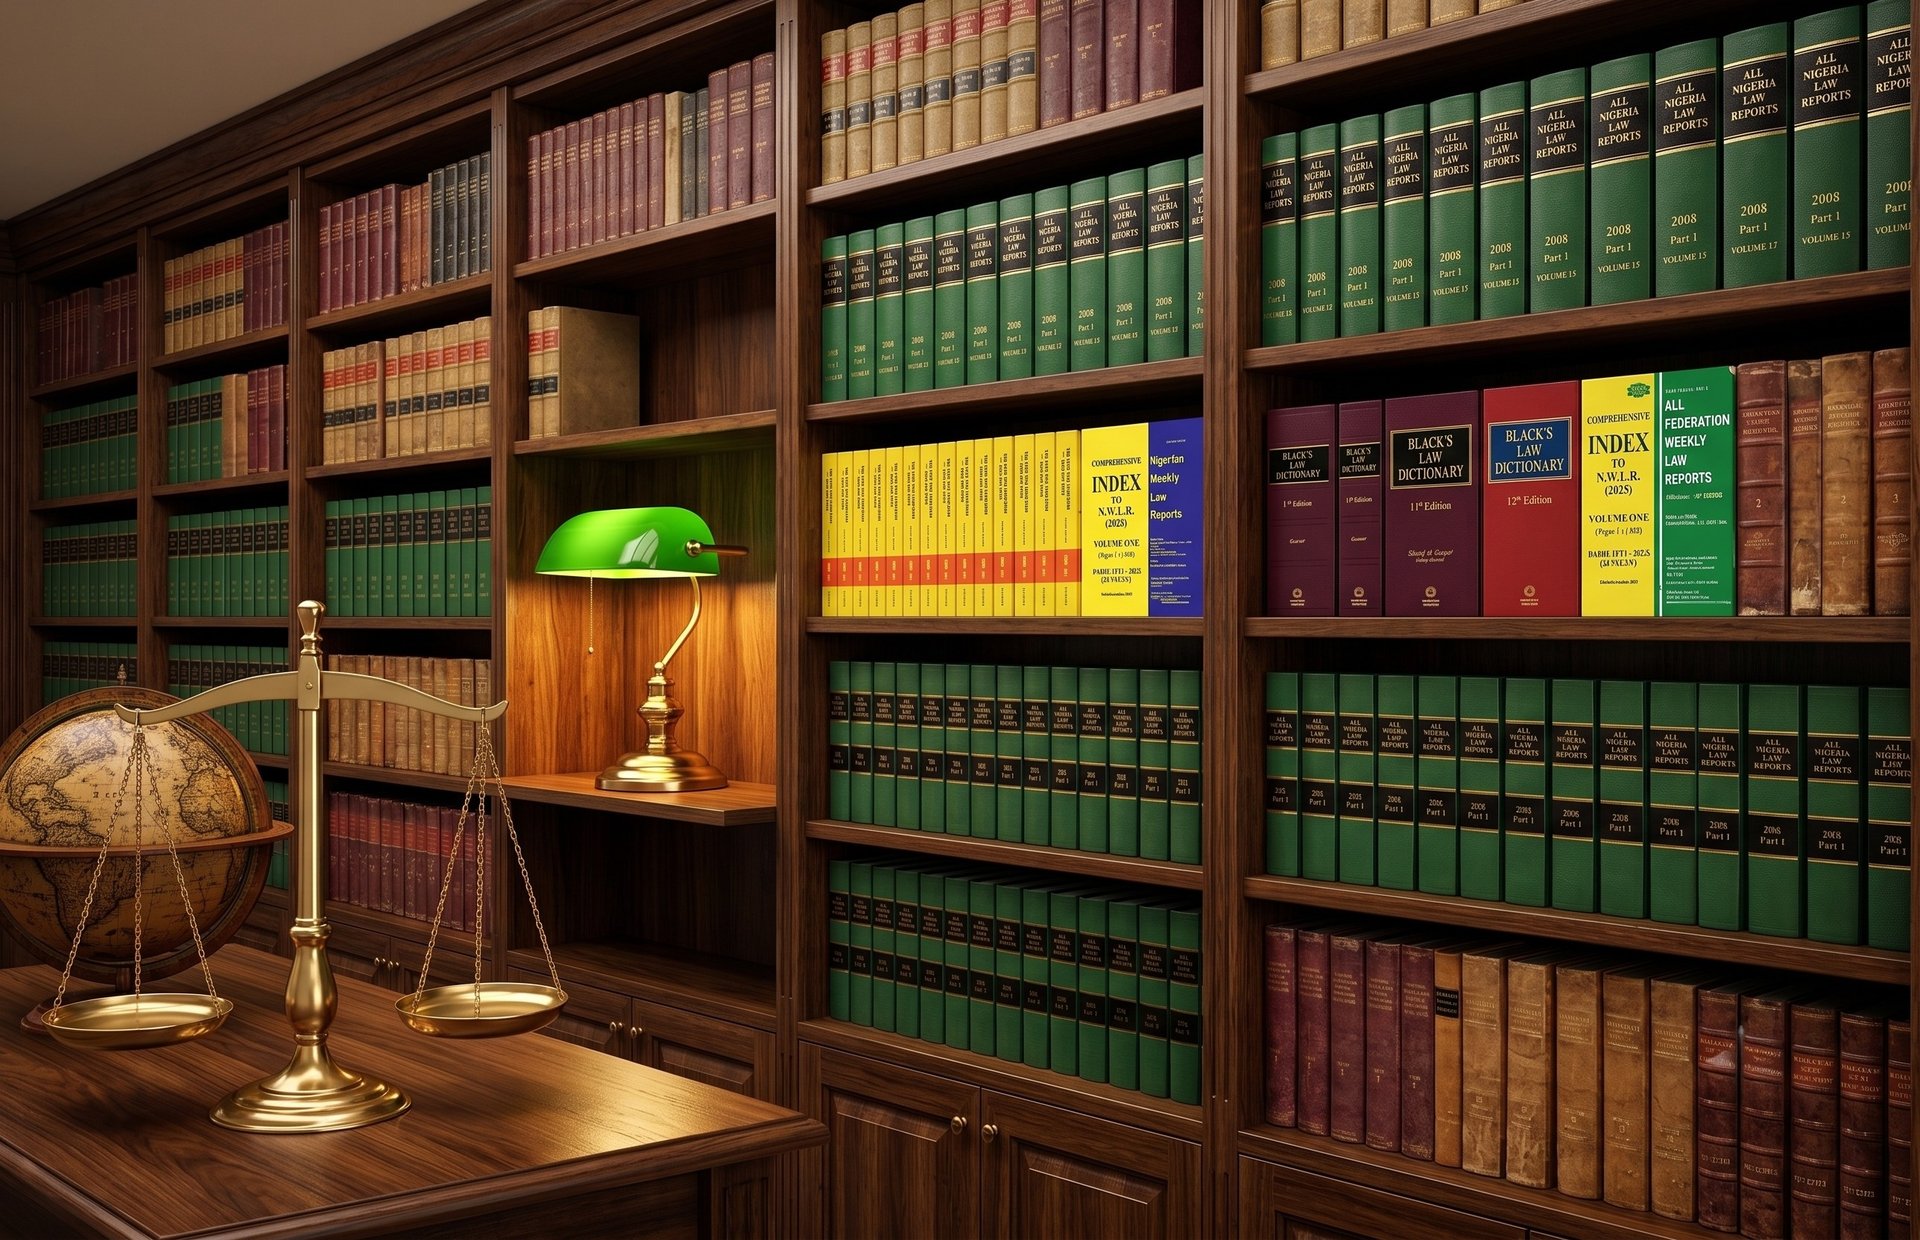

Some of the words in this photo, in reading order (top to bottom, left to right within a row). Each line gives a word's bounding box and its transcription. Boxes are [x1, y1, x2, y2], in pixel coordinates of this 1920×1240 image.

[1890, 37, 1910, 49] ALL
[1816, 53, 1836, 65] ALL
[1744, 68, 1763, 80] ALL
[1803, 64, 1849, 81] NIGERIA
[1675, 83, 1694, 94] ALL
[1733, 79, 1776, 95] NIGERIA
[1814, 79, 1838, 91] LAW
[1611, 97, 1628, 108] ALL
[1664, 93, 1706, 109] NIGERIA
[1743, 93, 1765, 105] LAW
[1802, 90, 1851, 107] REPORTS
[1548, 110, 1565, 121] ALL
[1599, 107, 1639, 122] NIGERIA
[1674, 107, 1696, 119] LAW
[1731, 104, 1778, 121] REPORTS
[1494, 122, 1509, 132] ALL
[1537, 120, 1575, 134] NIGERIA
[1609, 120, 1630, 132] LAW
[1663, 118, 1708, 134] REPORTS
[1443, 133, 1458, 143] ALL
[1485, 132, 1518, 145] NIGERIA
[1546, 133, 1567, 144] LAW
[1598, 131, 1641, 147] REPORTS
[1395, 143, 1410, 152] ALL
[1435, 142, 1468, 156] NIGERIA
[1492, 144, 1510, 156] LAW
[1536, 143, 1577, 159] REPORTS
[1351, 152, 1365, 161] ALL
[1388, 152, 1418, 164] NIGERIA
[1442, 155, 1459, 165] LAW
[1483, 154, 1520, 169] REPORTS
[1311, 161, 1323, 169] ALL
[1344, 161, 1373, 173] NIGERIA
[1394, 164, 1410, 174] LAW
[1304, 170, 1331, 181] NIGERIA
[1433, 164, 1469, 178] REPORTS
[1350, 173, 1365, 183] LAW
[1387, 174, 1420, 187] REPORTS
[1310, 181, 1324, 190] LAW
[1343, 182, 1374, 195] REPORTS
[1158, 194, 1170, 202] ALL
[1303, 191, 1332, 203] REPORTS
[1812, 192, 1839, 205] 2008
[1741, 203, 1767, 216] 2008
[1885, 203, 1907, 213] Part
[1671, 213, 1697, 226] 2008
[1811, 214, 1832, 224] Part
[1836, 212, 1840, 220] 1
[1606, 224, 1631, 237] 2008
[1740, 225, 1760, 234] Part
[1545, 234, 1568, 246] 2008
[1671, 235, 1689, 244] Part
[1693, 233, 1697, 241] 1
[1802, 233, 1839, 244] VOLUME
[1490, 243, 1512, 254] 2008
[1606, 245, 1624, 253] Part
[1732, 243, 1766, 254] VOLUME
[1440, 250, 1461, 262] 2008
[1544, 254, 1561, 263] Part
[1565, 252, 1568, 260] 1
[1663, 253, 1696, 264] VOLUME
[1393, 258, 1412, 269] 2008
[1489, 262, 1505, 271] Part
[1509, 260, 1512, 268] 1
[1598, 263, 1630, 273] VOLUME
[1632, 261, 1640, 269] 15
[1348, 265, 1367, 276] 2008
[1440, 269, 1455, 278] Part
[1308, 272, 1325, 282] 2008
[1393, 277, 1407, 285] Part
[1537, 272, 1567, 281] VOLUME
[1348, 283, 1361, 291] Part
[1483, 280, 1512, 289] VOLUME
[1308, 289, 1321, 297] Part
[1156, 297, 1172, 306] 2008
[1665, 399, 1684, 411] ALL
[1587, 412, 1650, 424] COMPREHENSIVE
[1665, 414, 1730, 429] FEDERATION
[1506, 427, 1553, 442] BLACK'S
[1408, 435, 1453, 450] BLACK'S
[1588, 432, 1649, 454] INDEX
[1665, 435, 1706, 448] WEEKLY
[1283, 451, 1313, 460] BLACK'S
[1346, 447, 1371, 456] BLACK'S
[1517, 444, 1542, 457] LAW
[1092, 457, 1142, 467] COMPREHENSIVE
[1419, 452, 1442, 464] LAW
[1611, 458, 1625, 468] TO
[1665, 455, 1687, 466] LAW
[1290, 461, 1305, 469] LAW
[1342, 464, 1376, 473] DICTIONARY
[1495, 458, 1564, 474] DICTIONARY
[1276, 470, 1320, 480] DICTIONARY
[1399, 465, 1463, 480] DICTIONARY
[1597, 471, 1640, 483] N.W.L.R.
[1092, 474, 1141, 493] INDEX
[1665, 472, 1712, 485] REPORTS
[1150, 493, 1167, 502] Law
[1524, 496, 1552, 505] Edition
[1841, 496, 1846, 504] 2
[1893, 494, 1898, 503] 3
[1425, 502, 1451, 511] Edition
[1756, 499, 1761, 508] 2
[1099, 506, 1134, 516] N.W.L.R.
[1150, 510, 1182, 521] Reports
[1629, 513, 1649, 522] ONE
[1124, 539, 1140, 547] ONE
[1814, 766, 1852, 774] REPORTS
[1706, 832, 1724, 840] Part
